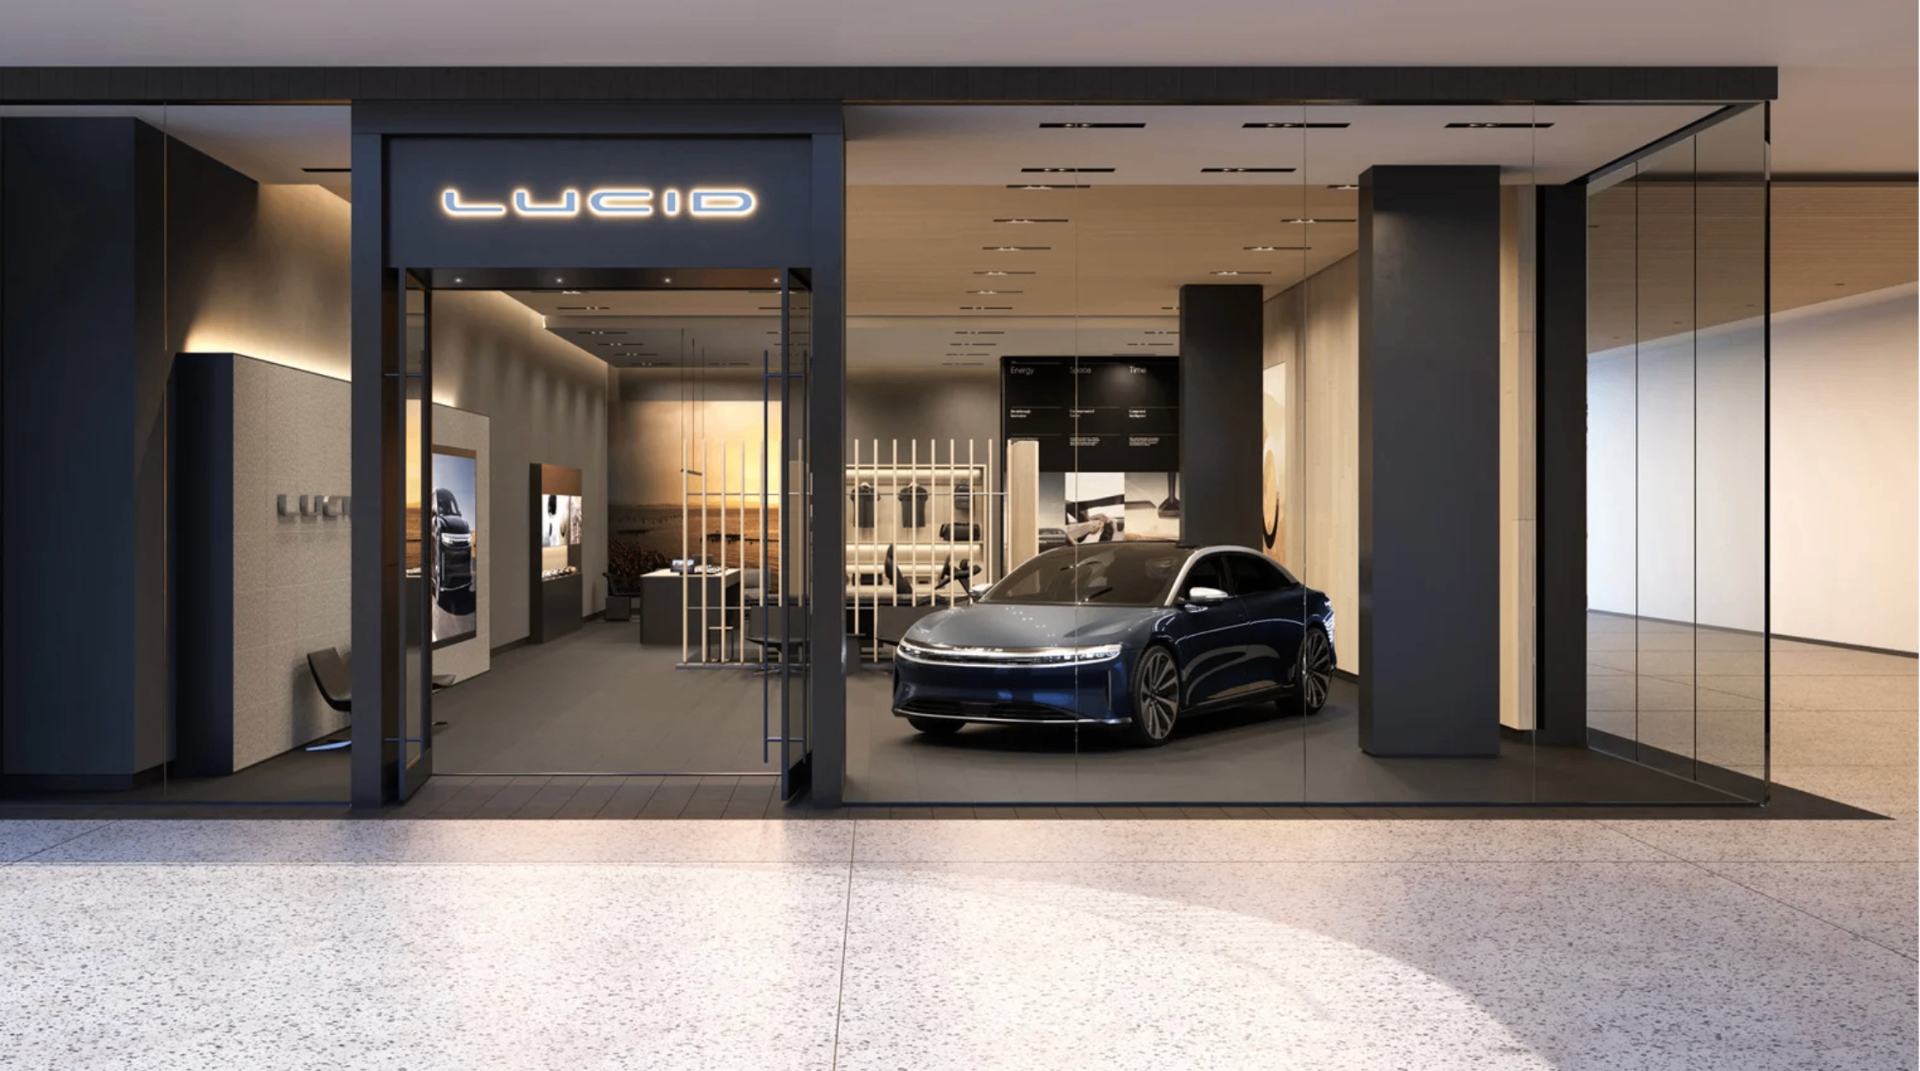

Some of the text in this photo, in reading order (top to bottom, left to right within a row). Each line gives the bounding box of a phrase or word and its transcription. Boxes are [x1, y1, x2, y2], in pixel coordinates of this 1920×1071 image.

[443, 190, 755, 214] LUCID
[1010, 366, 1034, 376] Energy
[1129, 366, 1147, 374] Time
[277, 494, 351, 516] LUCI
